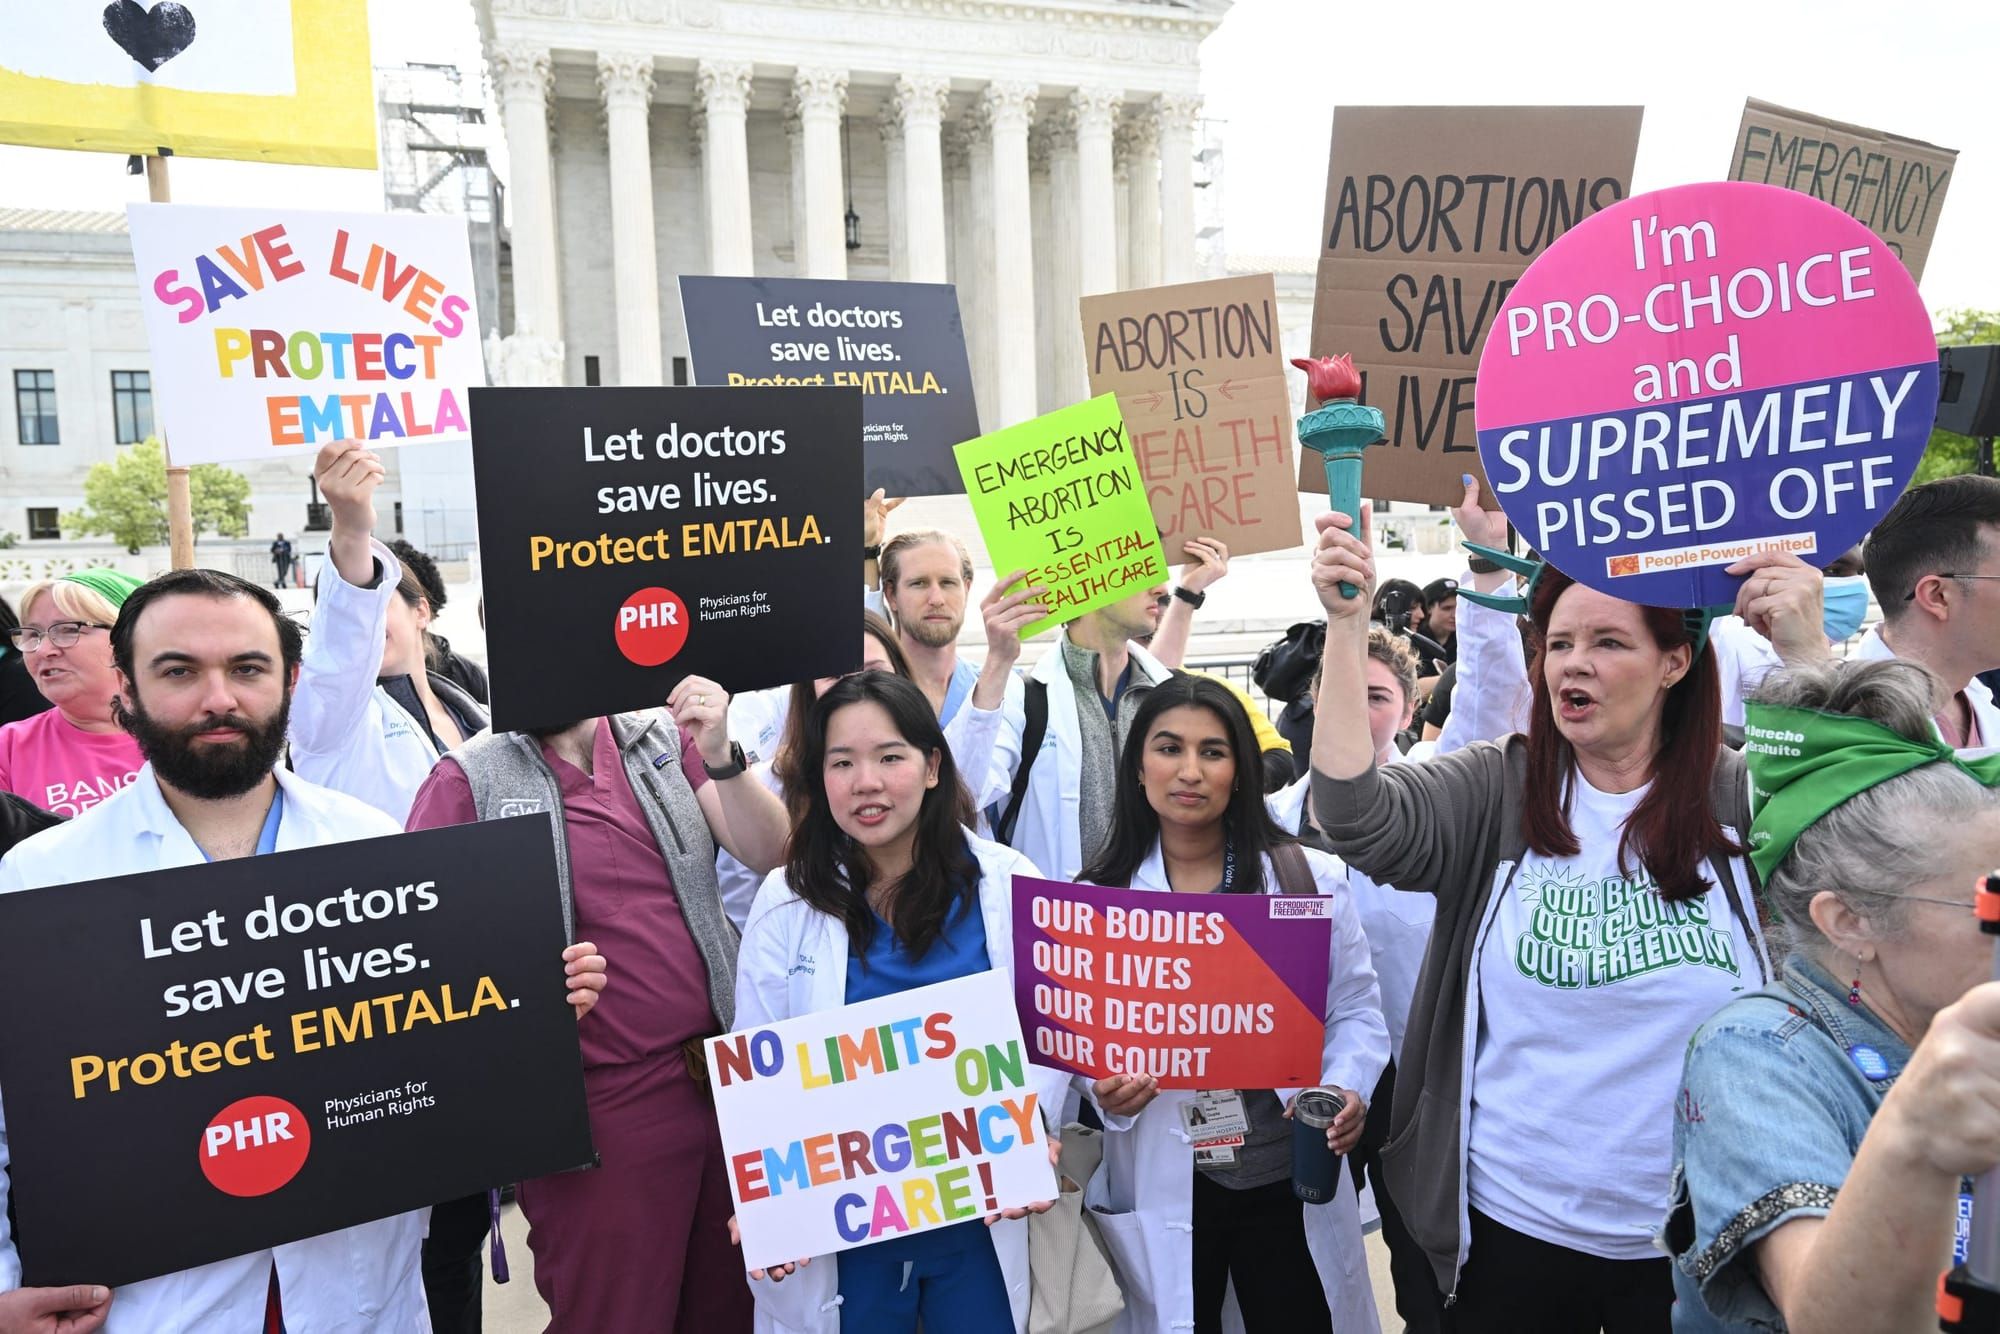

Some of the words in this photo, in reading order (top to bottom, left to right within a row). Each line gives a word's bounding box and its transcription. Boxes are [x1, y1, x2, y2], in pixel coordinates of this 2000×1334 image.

[1738, 126, 1948, 236] EMERGENCY
[1631, 216, 1717, 271] I’m
[153, 223, 305, 324] SAVE
[329, 228, 470, 338] LIVES
[1506, 245, 1876, 356] PRO-CHOICE
[756, 302, 801, 327] Let
[807, 302, 902, 328] doctors
[1095, 300, 1273, 374] ABORTION
[214, 328, 442, 380] PROTECT
[770, 340, 830, 362] save
[838, 336, 901, 362] lives.
[1633, 335, 1744, 404] and
[833, 371, 948, 395] EMTALA.
[1168, 369, 1208, 421] IS
[266, 387, 468, 446] EMTALA
[584, 426, 644, 462] Let
[655, 422, 786, 459] doctors
[884, 432, 909, 443] Rights
[892, 422, 904, 431] for
[1496, 370, 1921, 493] SUPREMELY
[975, 420, 1124, 494] EMERGENCY
[597, 481, 681, 514] save
[694, 472, 777, 507] lives.
[1007, 466, 1132, 531] ABORTION
[1536, 480, 1736, 551] PISSED
[1769, 455, 1895, 521] OFF
[530, 528, 670, 571] Protect
[682, 514, 832, 558] EMTALA.
[1025, 530, 1155, 588] ESSENTIAL
[1045, 526, 1084, 554] IS
[1645, 551, 1697, 569] People
[1701, 545, 1753, 561] Power
[1757, 536, 1814, 553] United
[700, 594, 749, 611] Physicians
[752, 590, 768, 603] for
[1024, 556, 1159, 615] EALTHCARE
[619, 602, 679, 631] PHR
[700, 607, 738, 622] Human
[740, 602, 771, 618] Rights
[139, 911, 228, 959] Let
[244, 878, 439, 944] doctors
[1032, 896, 1093, 936] OUR
[1106, 905, 1226, 945] BODIES
[1274, 901, 1324, 909] REPRODUCTIVE
[1274, 908, 1306, 916] FREEDOM
[1312, 908, 1324, 916] ALL
[1542, 881, 1598, 917] OUR
[1533, 906, 1596, 949] OUR
[163, 964, 286, 1018] save
[303, 941, 431, 992] lives.
[1032, 940, 1093, 981] OUR
[1106, 951, 1191, 990] LIVES
[1517, 935, 1581, 987] OUR
[1587, 927, 1739, 986] FREEDOM
[1034, 983, 1094, 1025] OUR
[1105, 993, 1275, 1035] DECISIONS
[69, 1023, 275, 1100] Protect
[291, 975, 520, 1054] EMTALA.
[713, 1029, 785, 1088] NO
[797, 1012, 956, 1090] LIMITS
[1035, 1025, 1096, 1067] OUR
[1104, 1040, 1211, 1078] COURT
[956, 1040, 1025, 1097] ON
[324, 1086, 401, 1117] Physicians
[405, 1078, 429, 1097] for
[326, 1107, 386, 1131] Human
[389, 1093, 436, 1121] Rights
[204, 1112, 295, 1158] PHR
[732, 1092, 1039, 1203] EMERGENCY
[834, 1162, 998, 1243] CARE!
